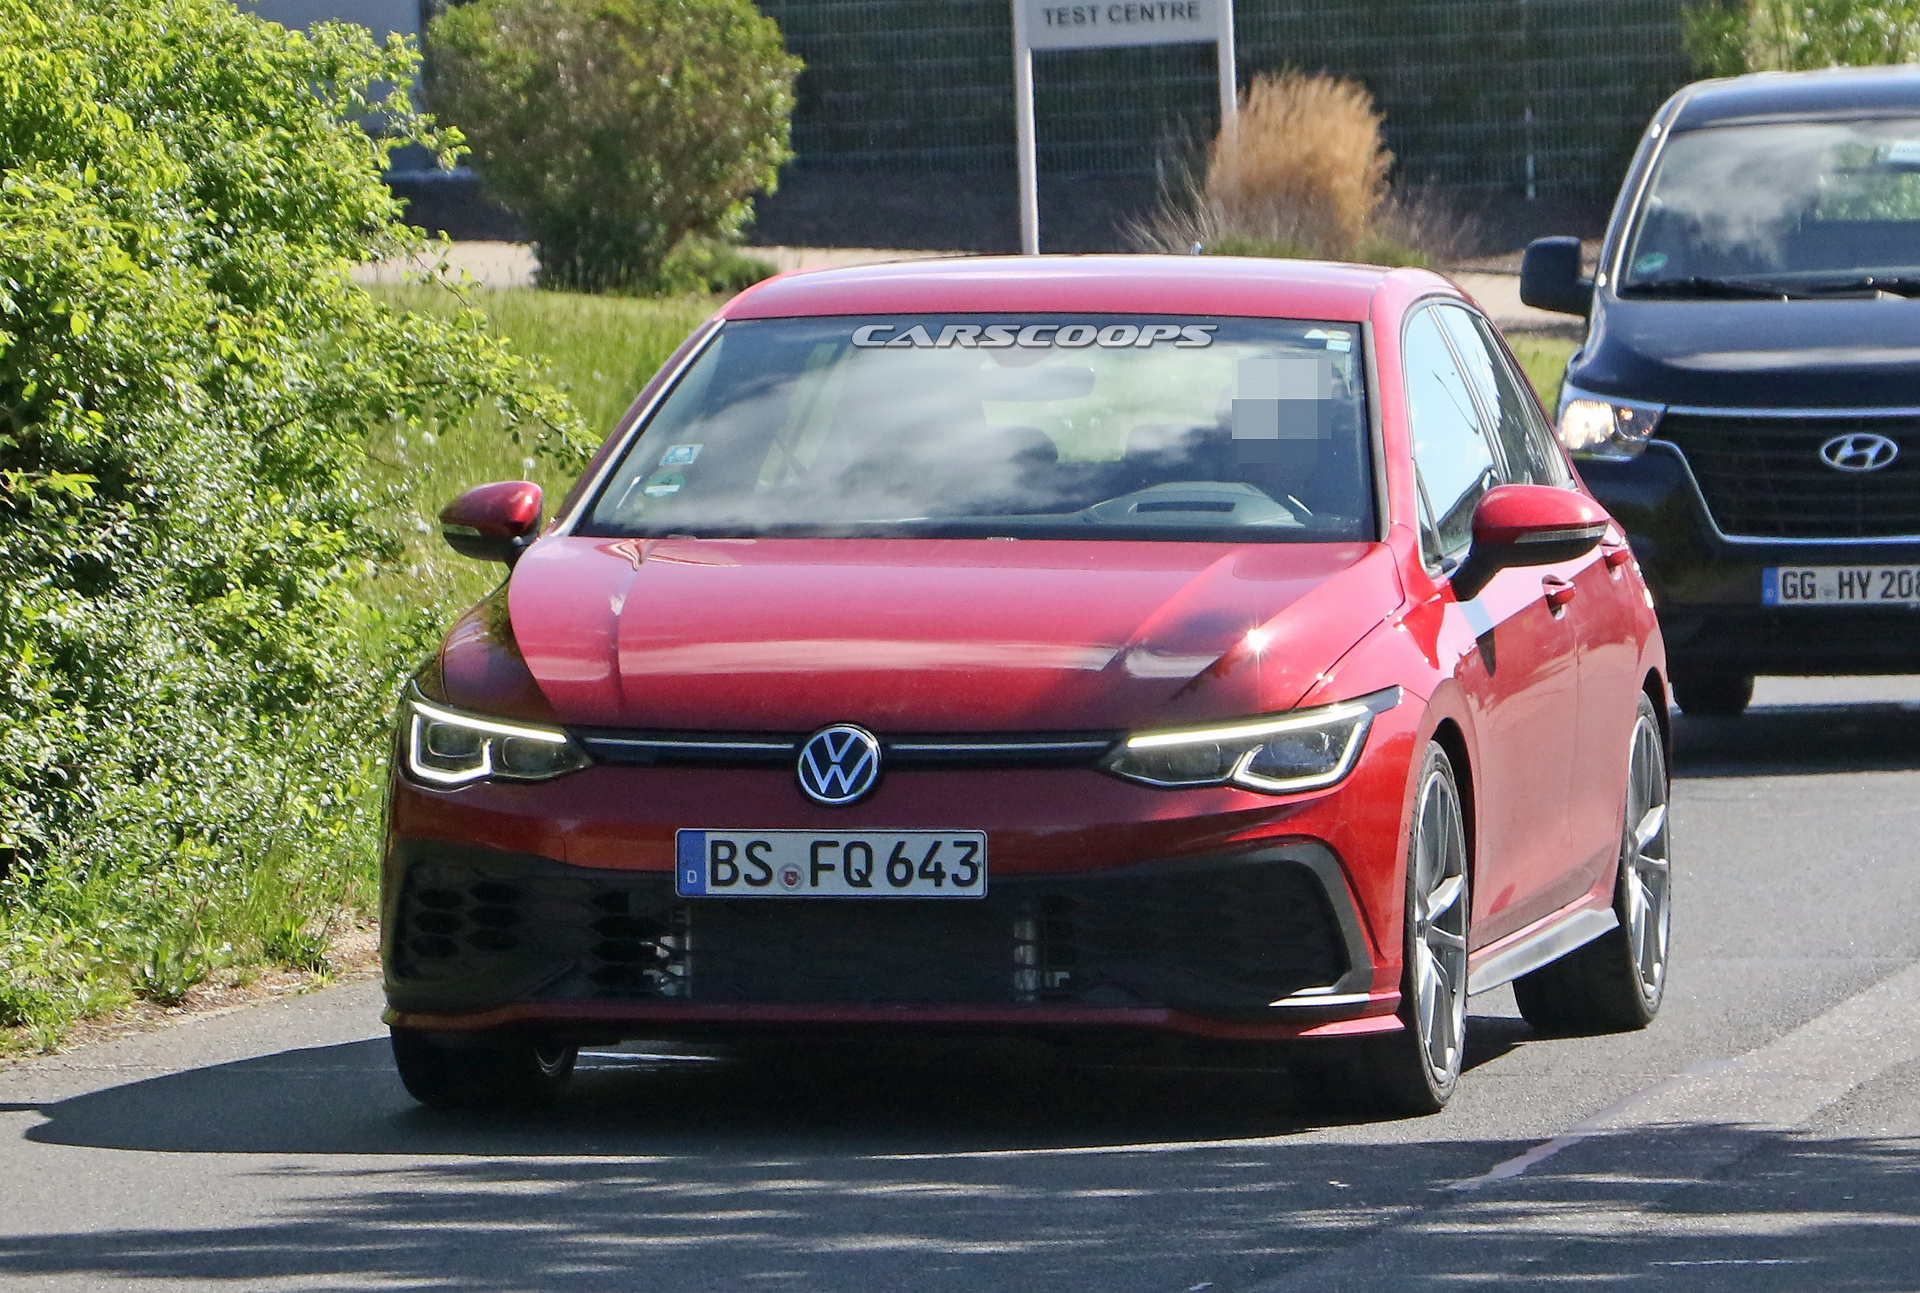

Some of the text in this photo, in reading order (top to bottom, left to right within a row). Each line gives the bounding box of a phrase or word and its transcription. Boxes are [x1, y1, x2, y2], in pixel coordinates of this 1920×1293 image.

[1042, 2, 1200, 25] TEST CENTRE
[1782, 570, 1816, 599] GG
[1838, 570, 1872, 599] HY
[687, 840, 980, 888] D BS FQ 643
